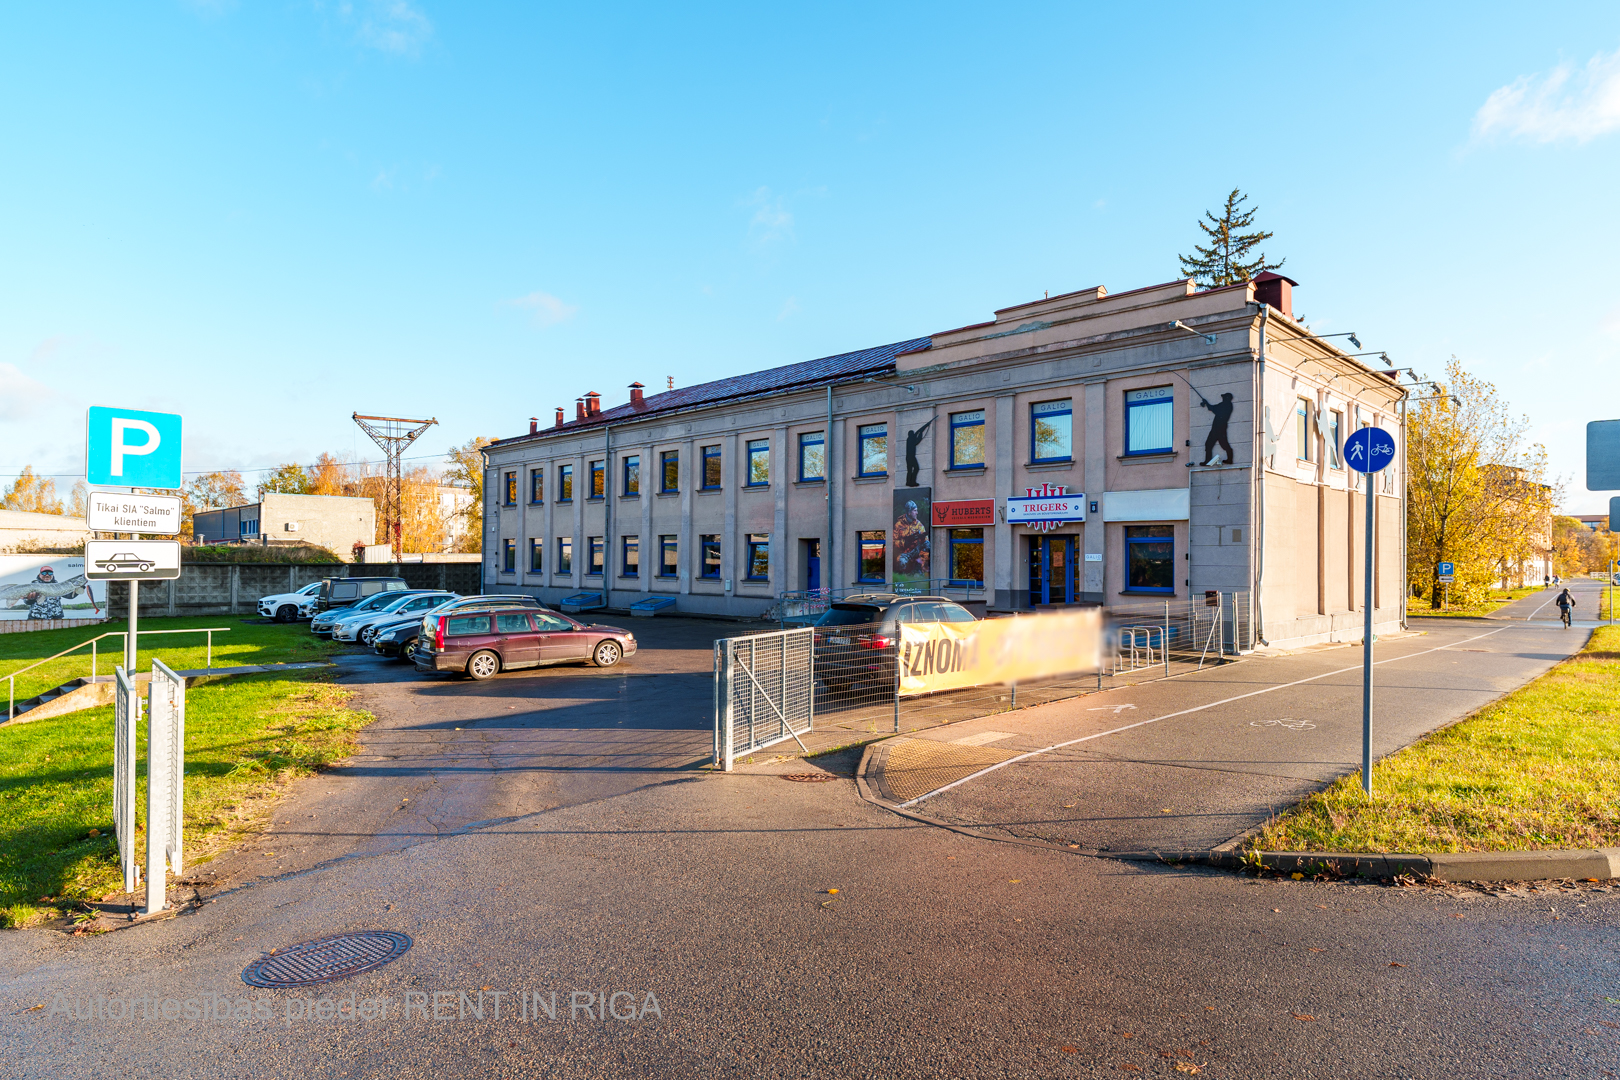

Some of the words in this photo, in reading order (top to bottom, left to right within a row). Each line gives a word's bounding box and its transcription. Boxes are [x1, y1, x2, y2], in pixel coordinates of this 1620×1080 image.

[1135, 389, 1166, 400] GALIO
[1040, 402, 1066, 412] GALIO
[958, 412, 981, 422] GALIO
[865, 425, 885, 433] GALIO
[110, 417, 161, 477] P
[96, 502, 119, 513] Tikai
[122, 504, 137, 514] SIA
[139, 505, 175, 516] "Salmo"
[951, 506, 991, 516] HUBERTS
[1022, 502, 1068, 513] TRIGERS
[114, 516, 157, 527] klientiem
[1442, 563, 1452, 574] P
